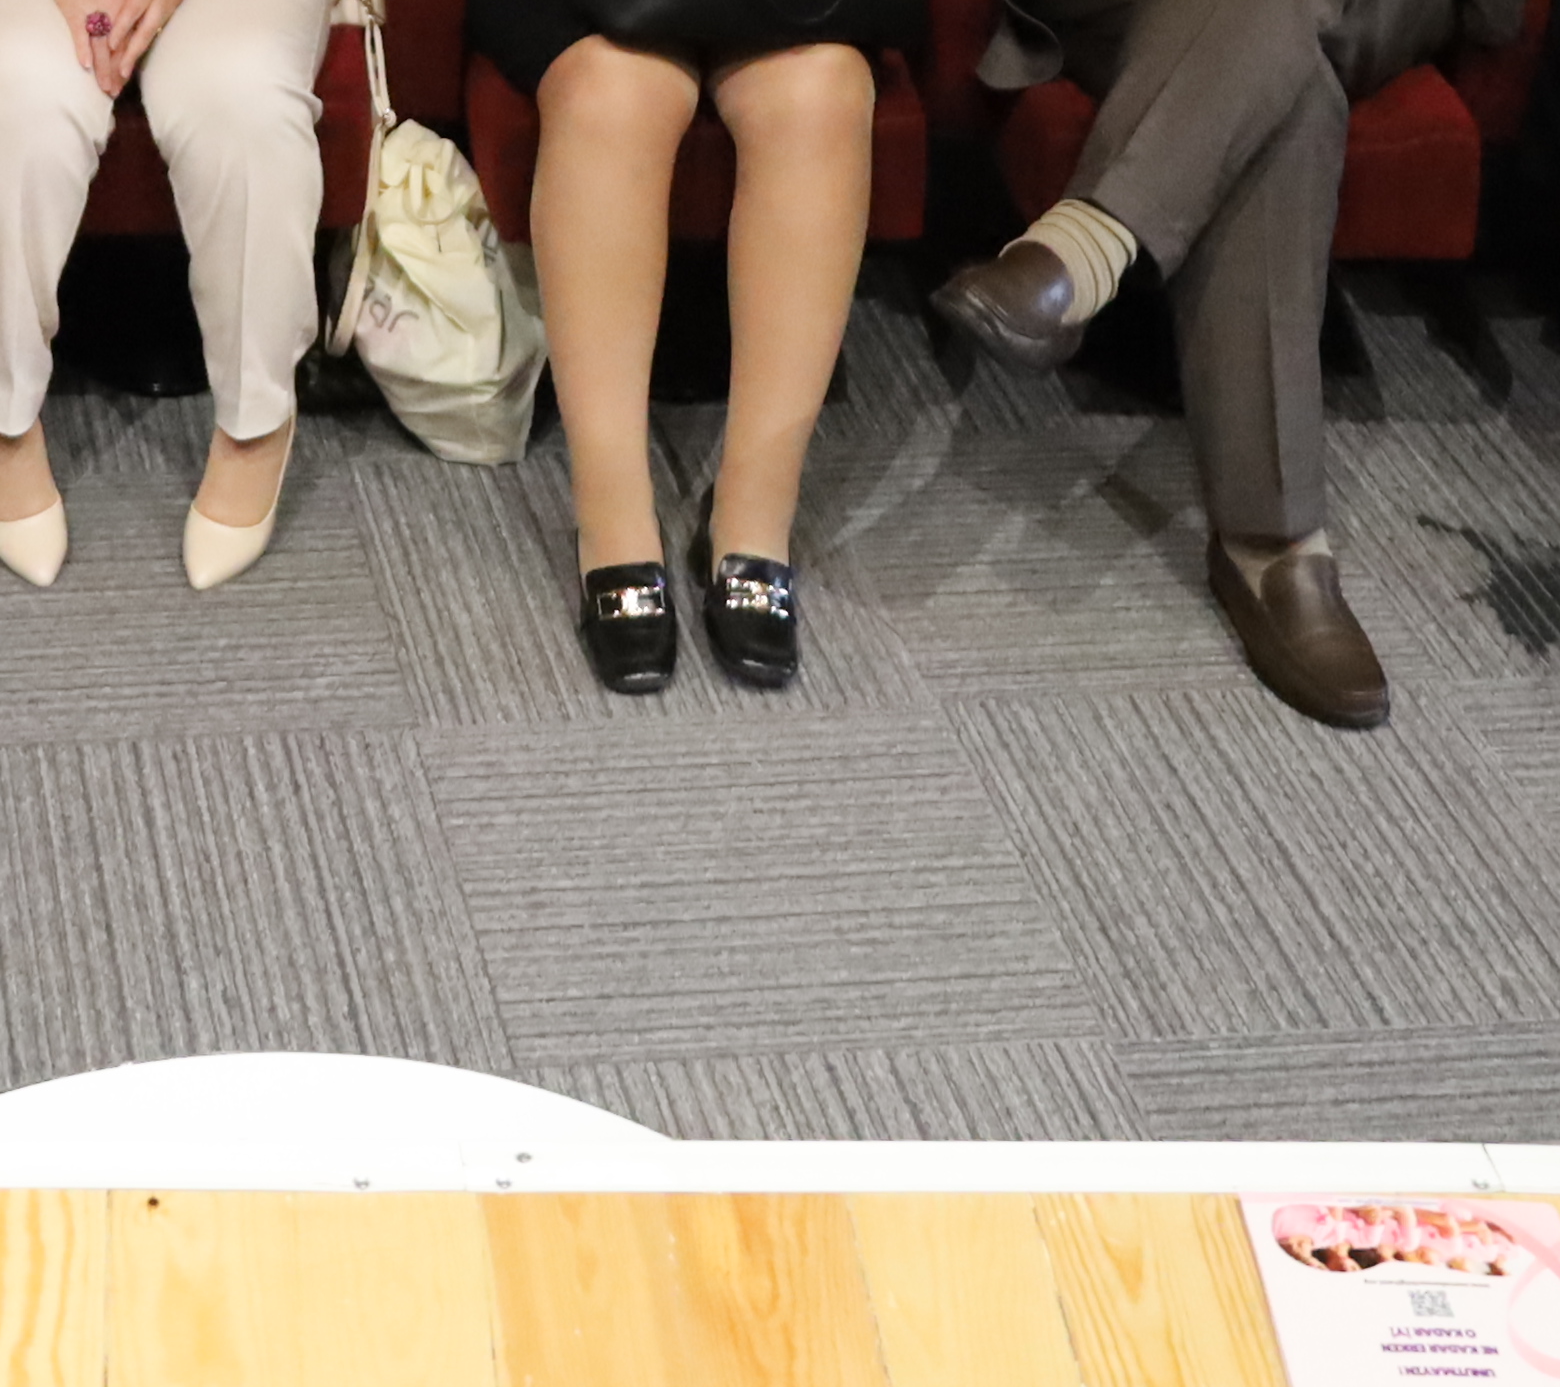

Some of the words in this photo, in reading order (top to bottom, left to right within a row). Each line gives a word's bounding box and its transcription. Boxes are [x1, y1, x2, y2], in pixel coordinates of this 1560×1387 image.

[1414, 1328, 1463, 1338] KADAR
[1465, 1329, 1476, 1338] O
[1381, 1343, 1427, 1353] ERKEN
[1429, 1344, 1480, 1354] KADAR
[1482, 1345, 1499, 1355] NE
